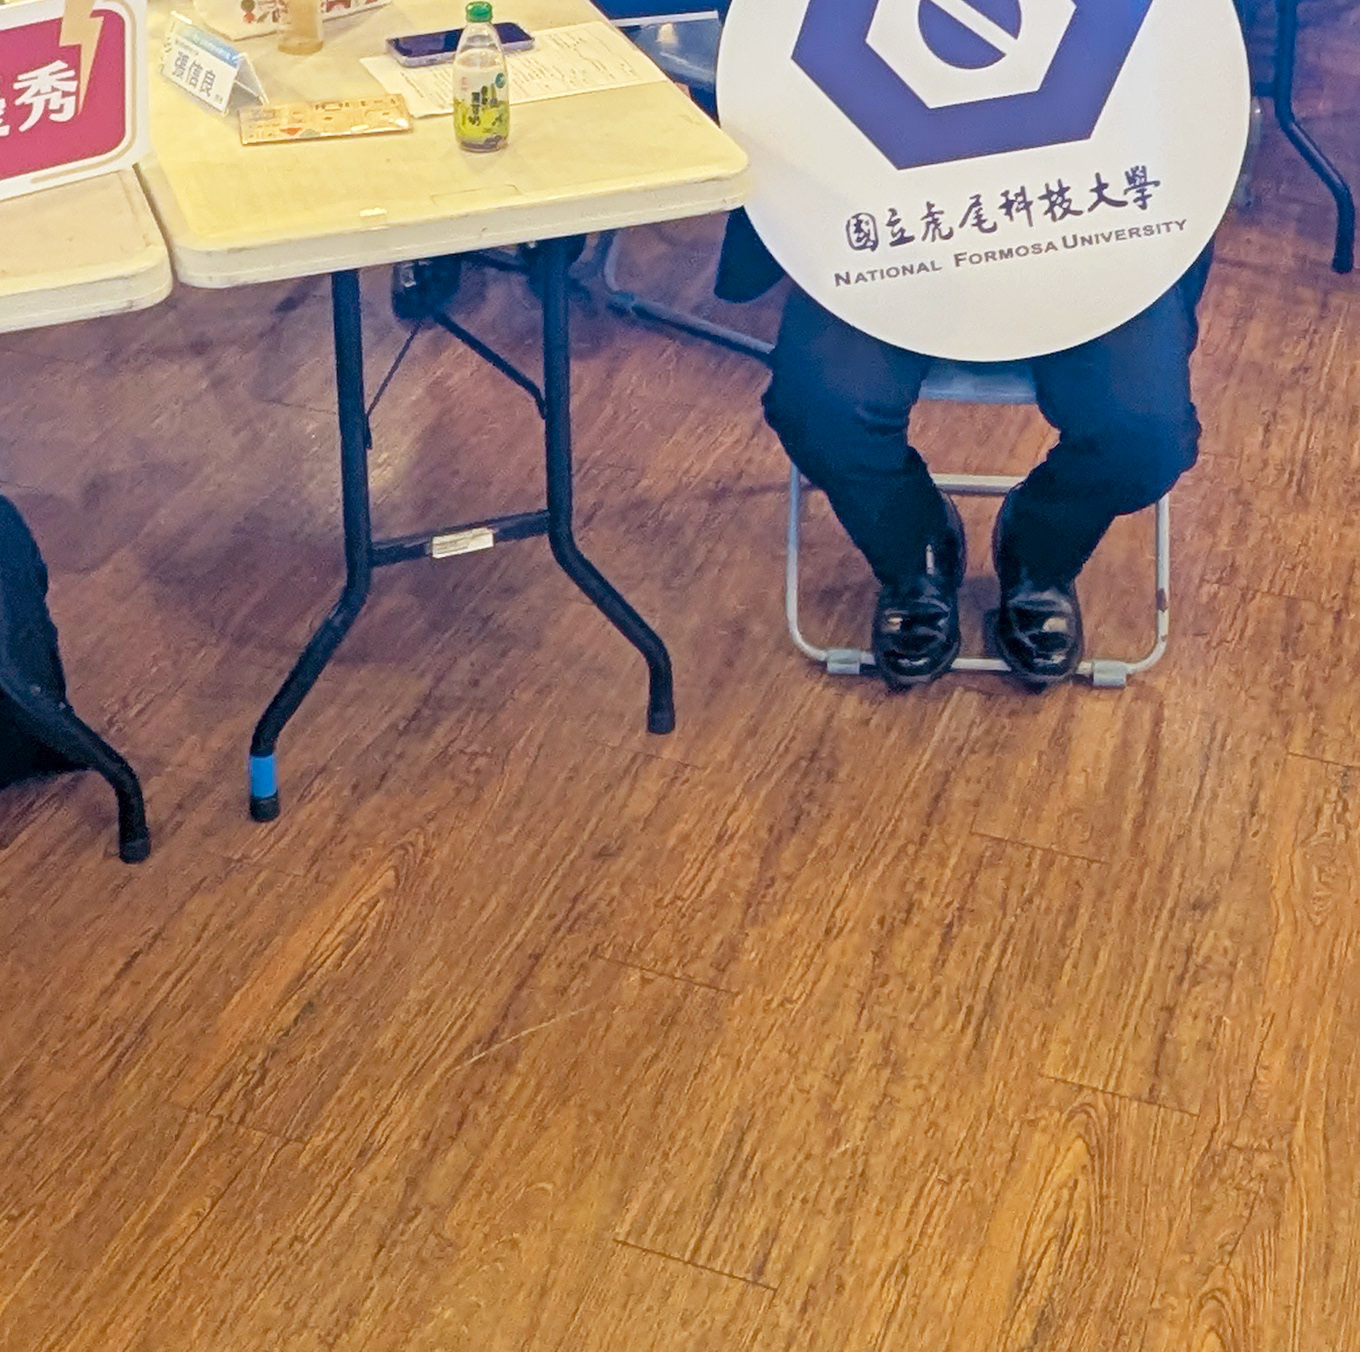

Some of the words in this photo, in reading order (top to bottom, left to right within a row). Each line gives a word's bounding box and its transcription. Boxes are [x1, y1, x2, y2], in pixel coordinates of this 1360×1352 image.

[846, 165, 1161, 251] 國立虎尾科技大學
[834, 259, 942, 286] NATIONAL
[954, 239, 1058, 267] FORMOSA
[1062, 218, 1188, 250] UNIVERSITY
